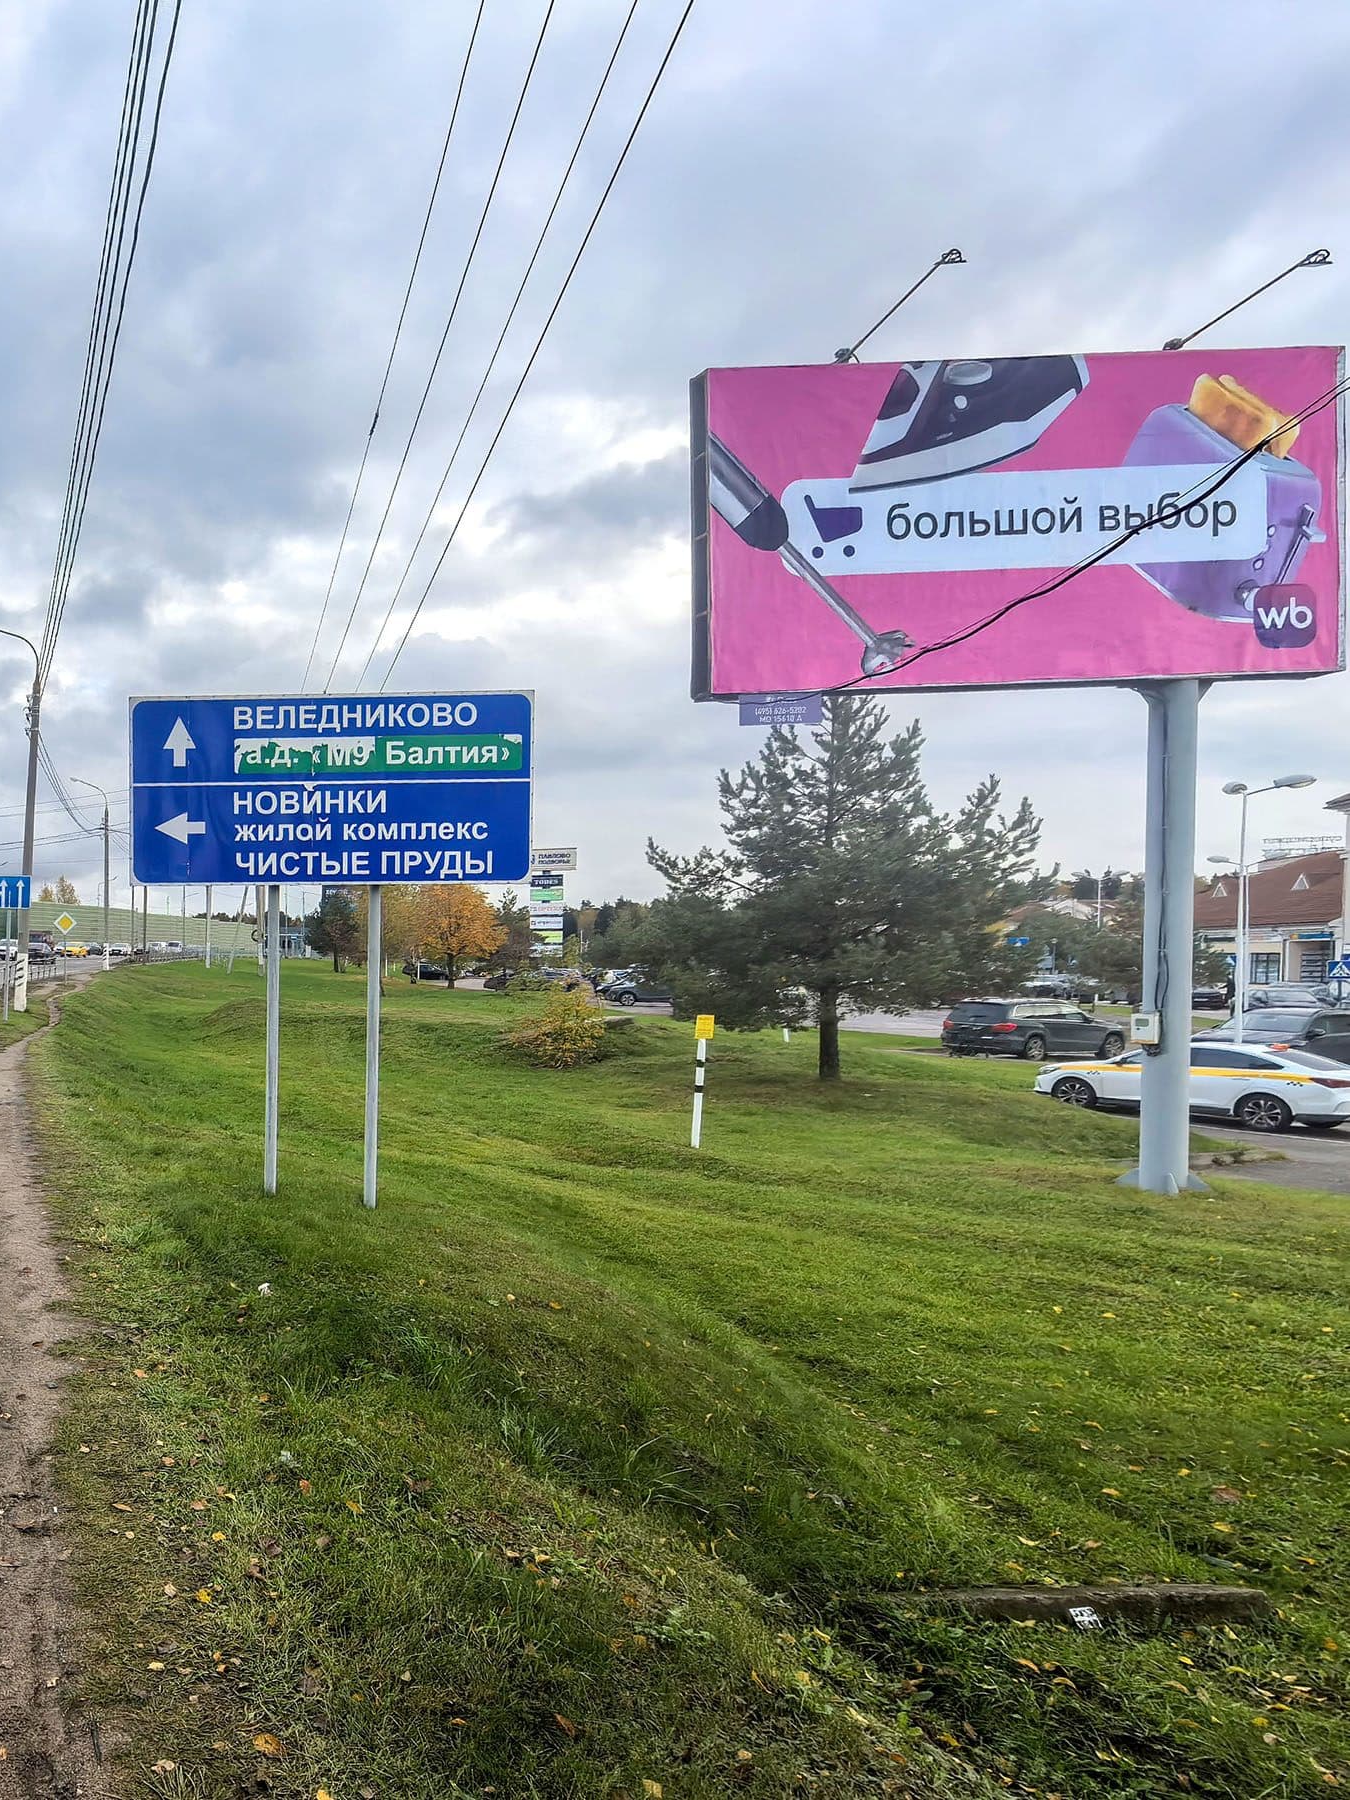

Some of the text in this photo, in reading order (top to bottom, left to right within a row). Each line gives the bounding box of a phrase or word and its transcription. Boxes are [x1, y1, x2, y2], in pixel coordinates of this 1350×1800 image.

[886, 491, 1238, 541] большой выбор
[1256, 596, 1313, 629] wb
[233, 702, 478, 733] ВЕЛЕДНИКОВО
[245, 745, 299, 768] а.д.
[385, 740, 511, 766] Балтия»
[233, 790, 388, 816] НОВИНКИ
[234, 817, 490, 843] жилой комплекс
[235, 850, 494, 880] ЧИСТЫЕ ПРУДЫ
